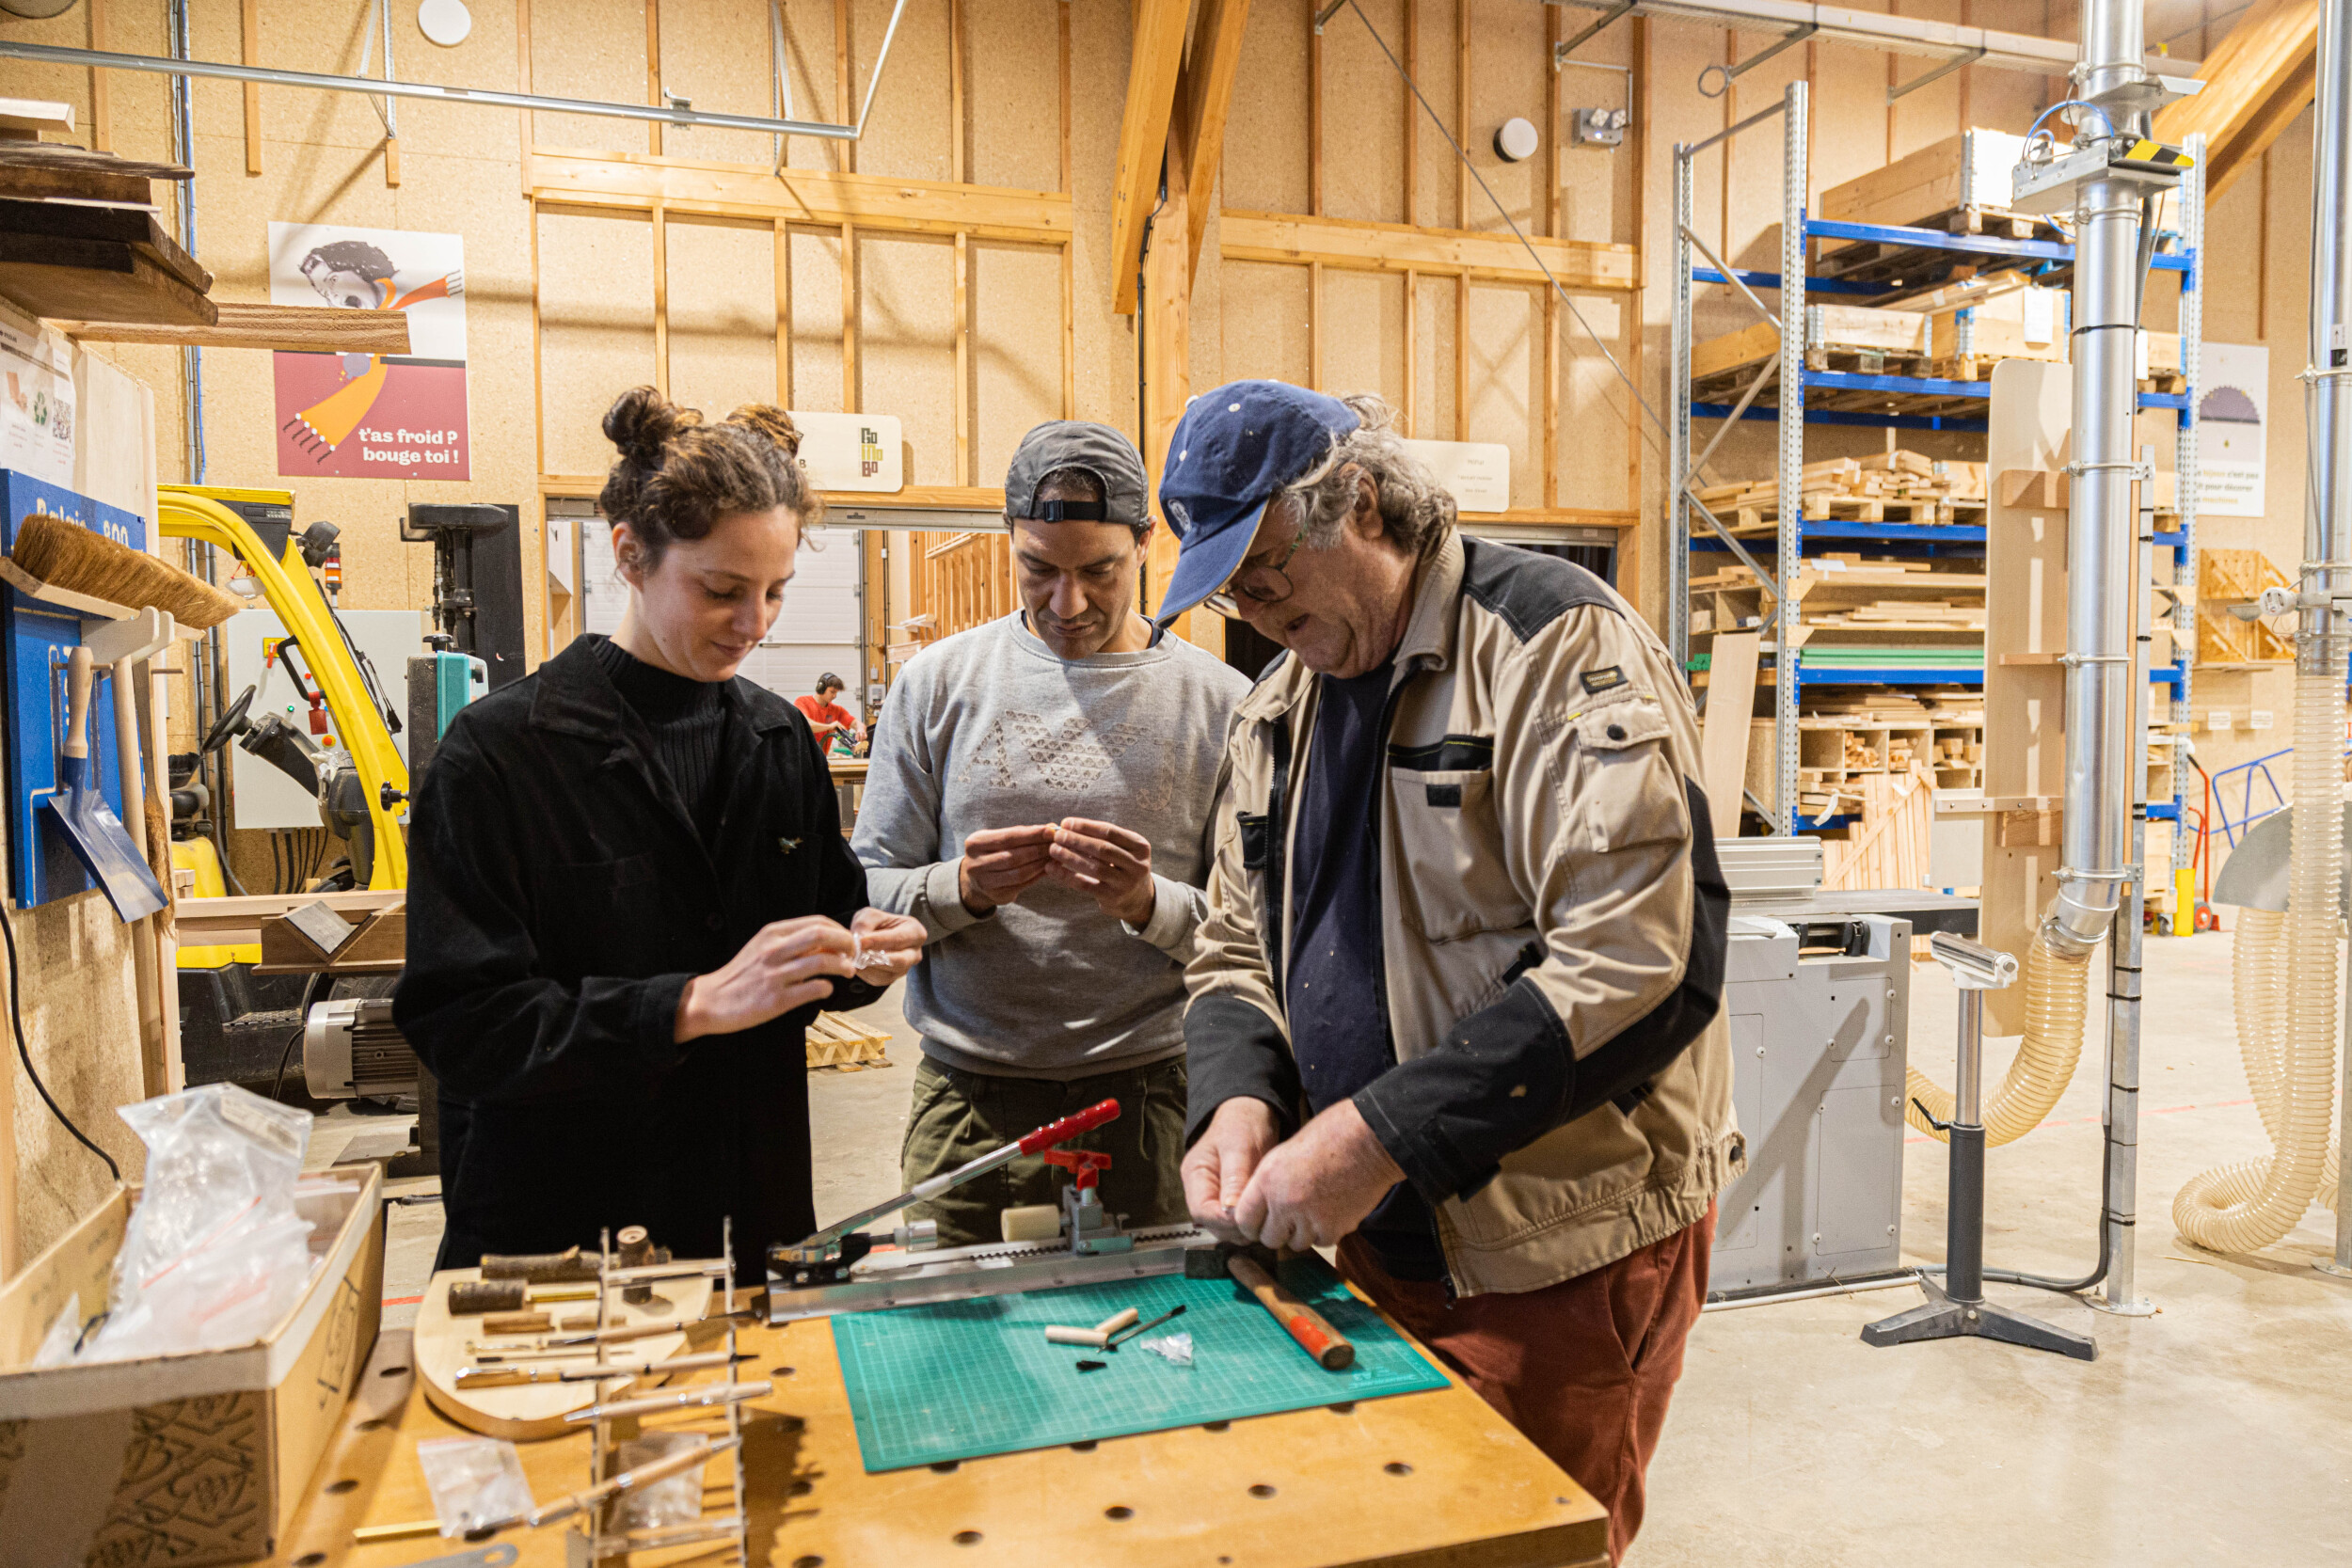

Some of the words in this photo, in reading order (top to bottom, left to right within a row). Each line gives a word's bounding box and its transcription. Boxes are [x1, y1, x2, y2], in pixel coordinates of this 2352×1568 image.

[358, 427, 394, 443] t'as
[396, 428, 444, 445] froid
[446, 430, 459, 445] ?
[362, 446, 421, 466] bouge
[423, 449, 450, 464] toi
[453, 449, 459, 464] !
